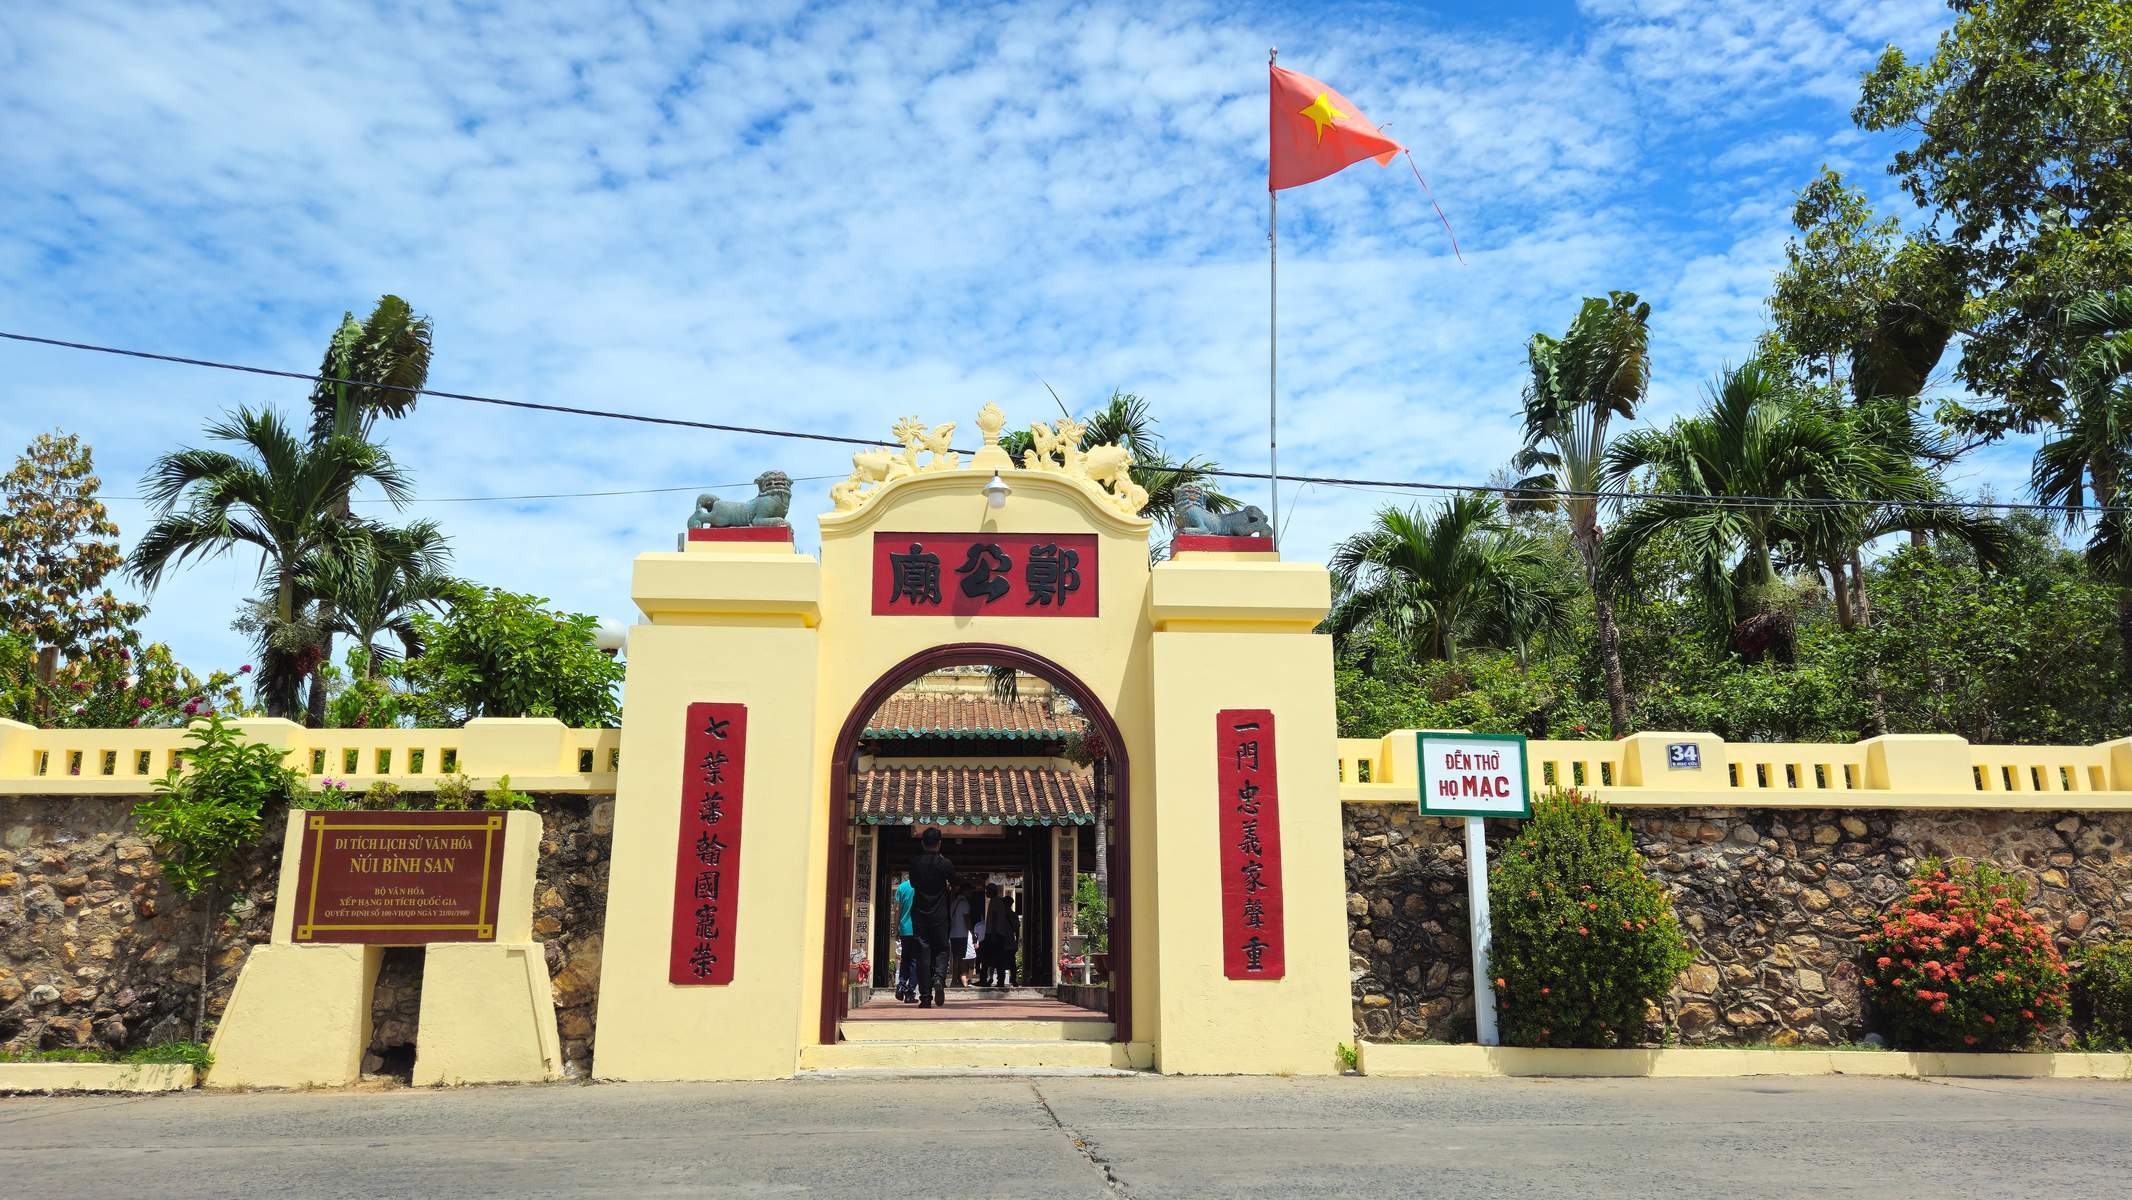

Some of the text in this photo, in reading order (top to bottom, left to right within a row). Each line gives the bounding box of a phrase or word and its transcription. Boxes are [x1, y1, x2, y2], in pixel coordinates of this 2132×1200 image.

[1474, 749, 1500, 771] THỜ
[1671, 745, 1697, 761] 34
[1439, 775, 1510, 802] HỌ MẠC
[335, 834, 473, 852] DI TÍCH LỊCH SỬ VĂN HÓA
[1233, 721, 1270, 974] 一門忠義家聲重
[350, 853, 456, 873] NÚI BÌNH SAN
[374, 886, 425, 896] BỘ VĂN HÓA
[358, 898, 382, 907] HẠNG
[395, 897, 416, 906] TÍCH
[416, 895, 440, 907] QUỐC
[442, 898, 457, 906] GIA
